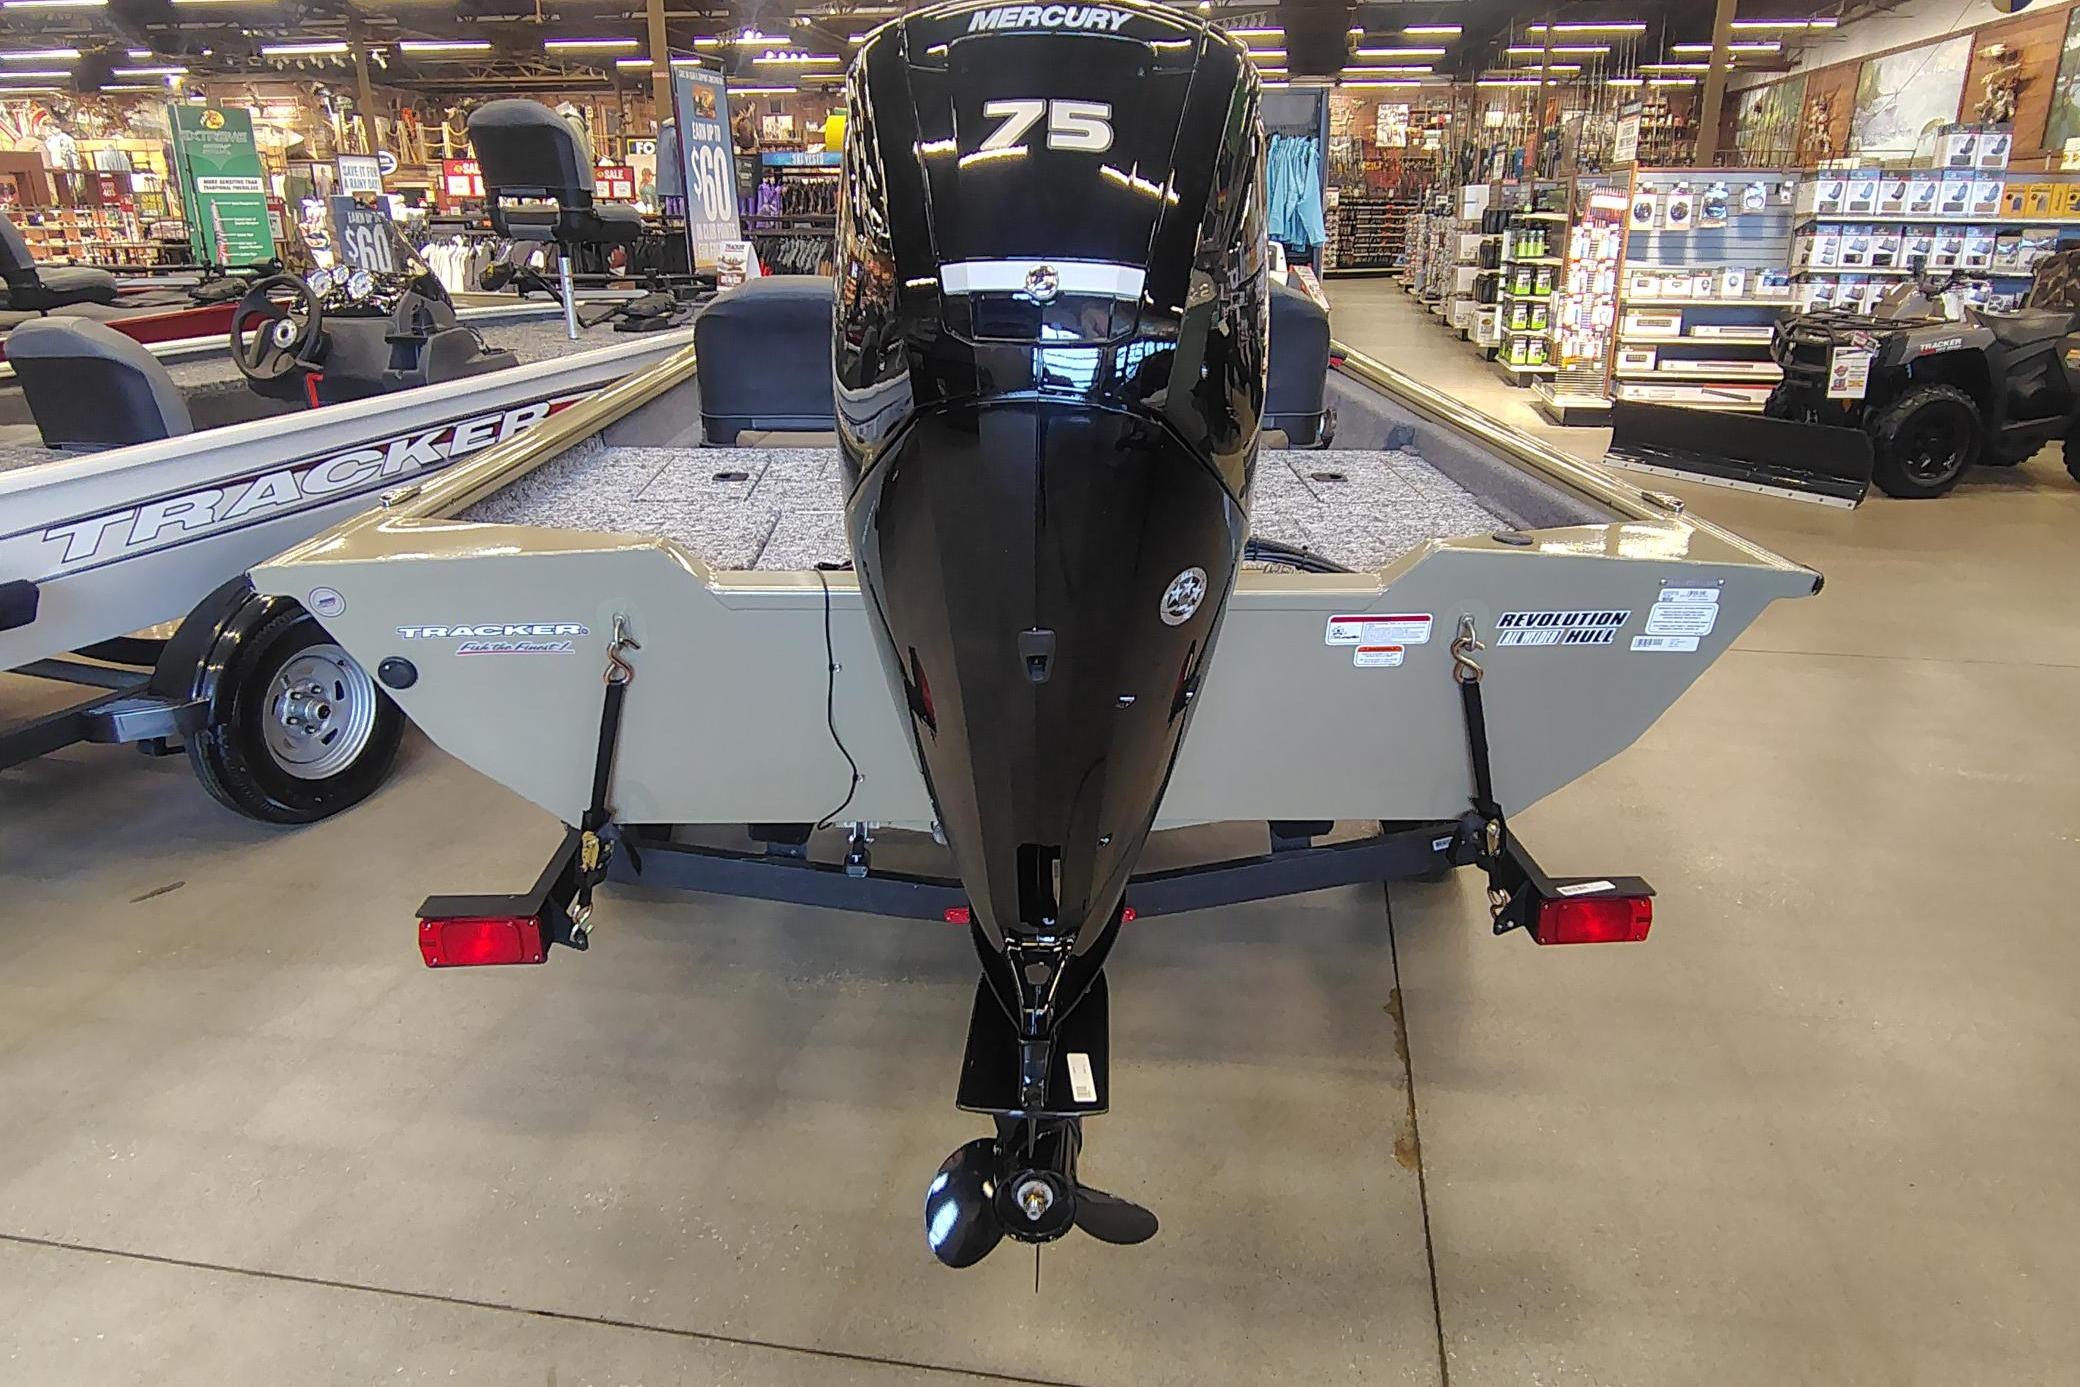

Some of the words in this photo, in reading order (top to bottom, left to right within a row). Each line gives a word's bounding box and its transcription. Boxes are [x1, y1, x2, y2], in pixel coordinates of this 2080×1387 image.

[967, 5, 1135, 33] MERCURY
[691, 121, 707, 141] EARN
[706, 123, 714, 142] UP
[714, 124, 721, 142] TO
[980, 98, 1115, 152] 75
[180, 130, 248, 143] EXTREME
[804, 153, 824, 165] VESTS
[342, 165, 359, 177] SAVE
[359, 165, 366, 177] IT
[366, 165, 378, 177] FOR
[463, 162, 481, 175] SAL
[604, 169, 624, 180] SALE
[349, 179, 366, 189] RAINY
[691, 144, 732, 222] $60
[347, 211, 365, 223] EARN
[345, 223, 393, 274] $60
[1919, 338, 1962, 352] TRACKER
[42, 400, 551, 563] TRACKER
[1499, 612, 1628, 627] REVOLUTION
[397, 624, 581, 639] TRACKER
[1564, 629, 1614, 643] HULL
[459, 641, 490, 652] Fish
[490, 641, 513, 651] the
[514, 640, 571, 651] Finest!
